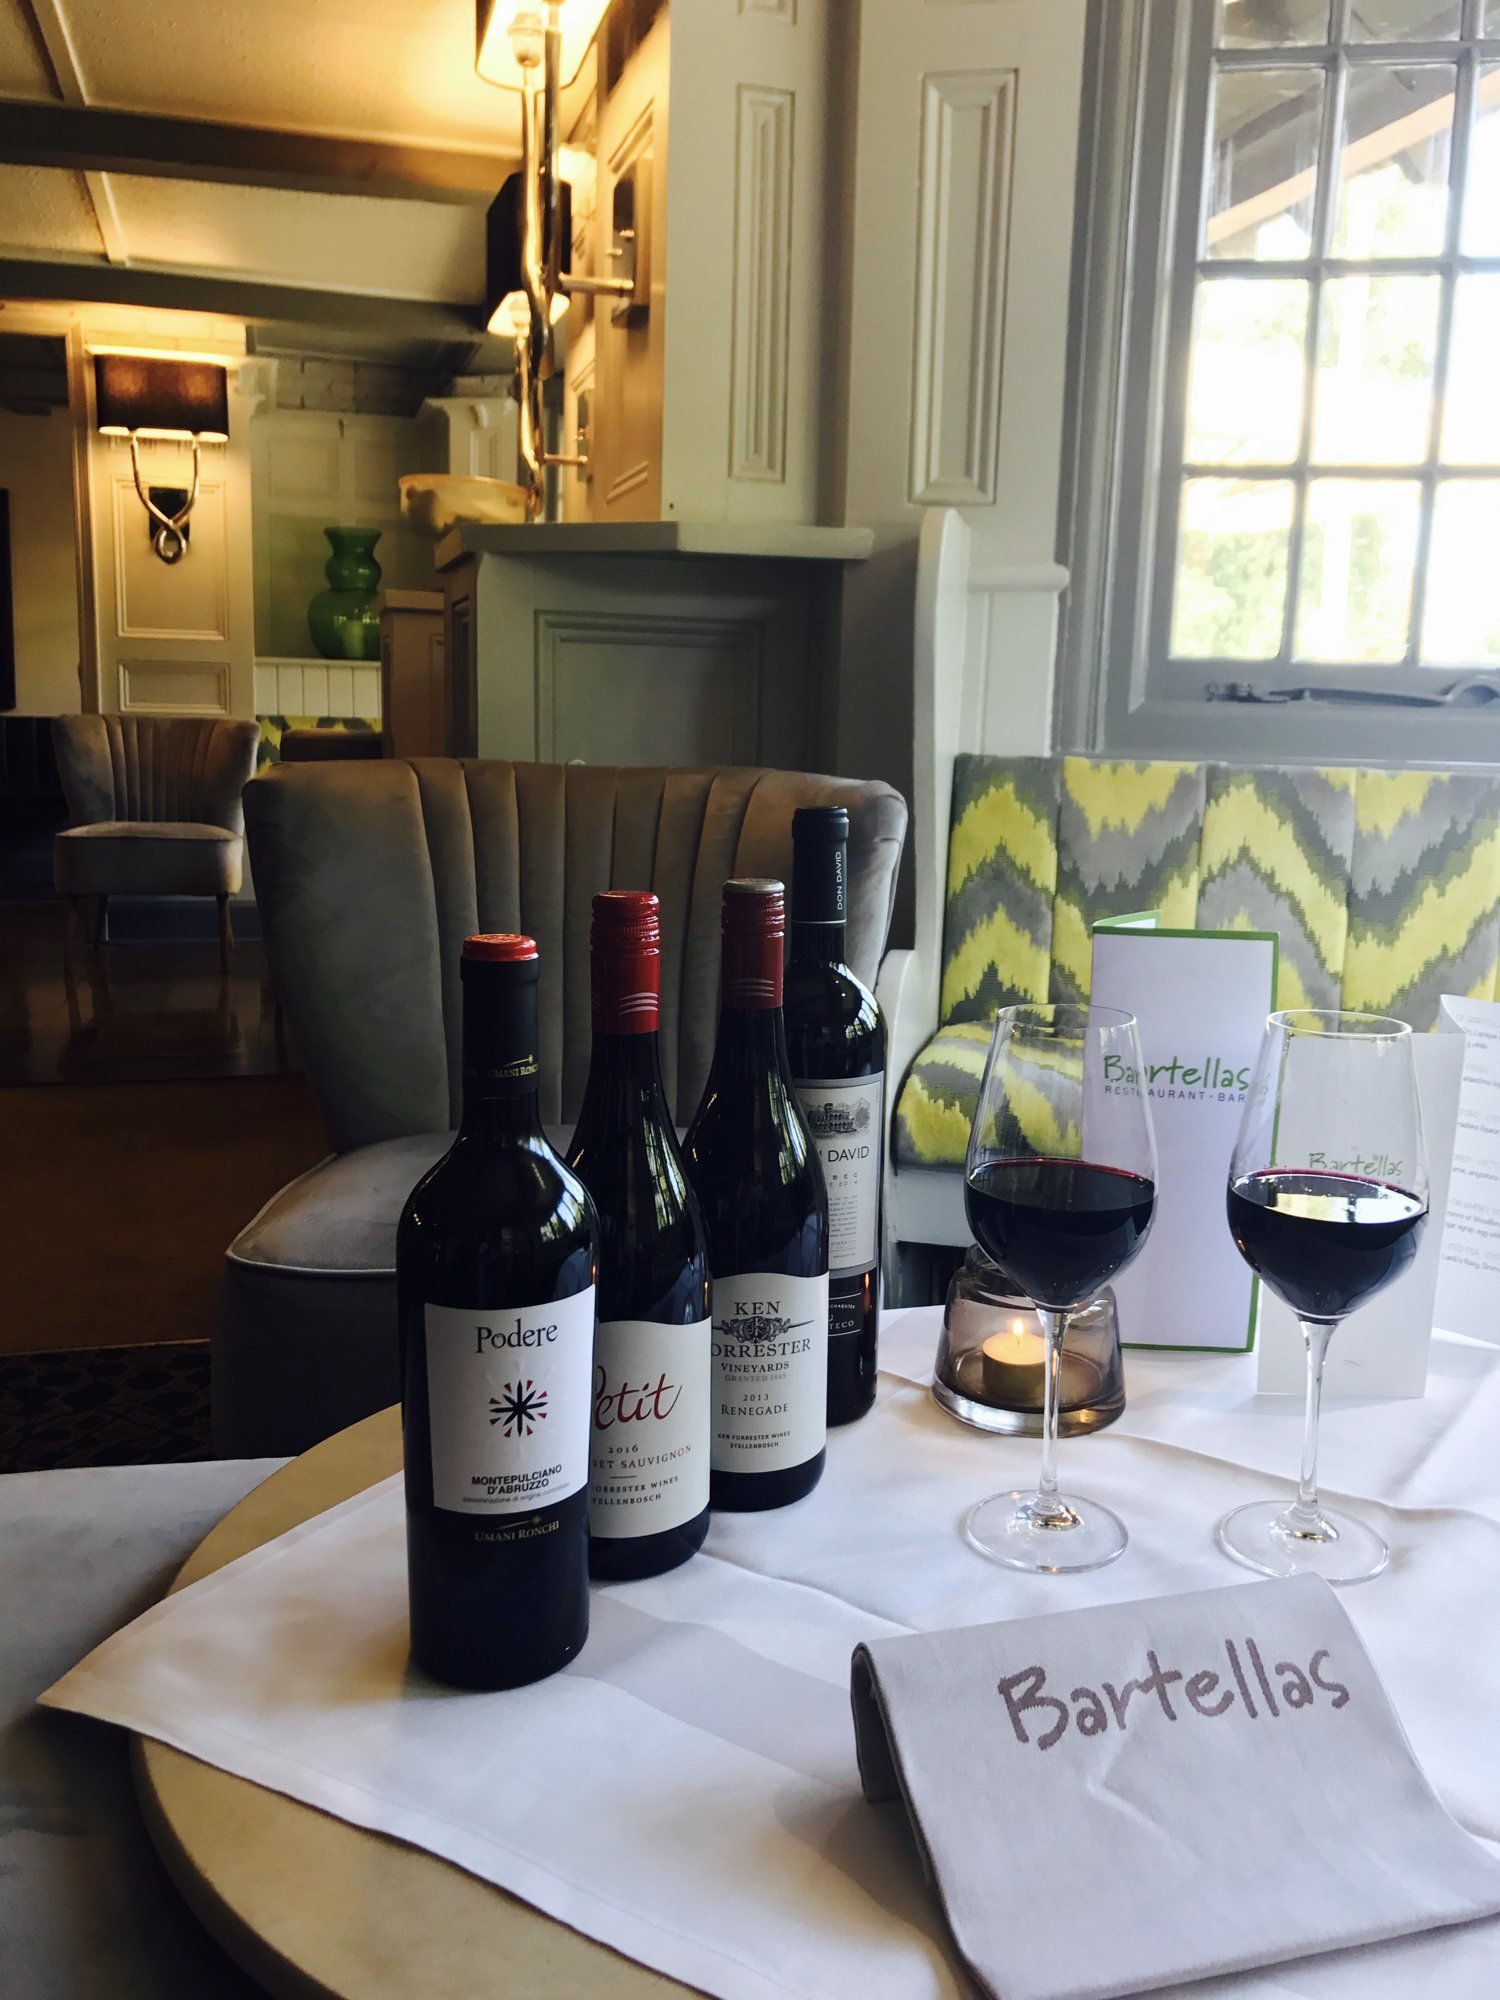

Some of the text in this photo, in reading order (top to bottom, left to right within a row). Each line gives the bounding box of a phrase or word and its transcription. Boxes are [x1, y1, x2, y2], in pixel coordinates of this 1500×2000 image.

[835, 851, 843, 882] DAVID
[1103, 1054, 1250, 1091] Bartellas
[828, 1145, 870, 1163] DAVID
[1308, 1152, 1403, 1176] Bartellas
[734, 1300, 781, 1316] KEN
[828, 1319, 855, 1330] TECO
[475, 1318, 558, 1354] Podere
[711, 1338, 811, 1358] ORRESTER
[721, 1361, 790, 1374] VINEYARDS
[742, 1393, 769, 1402] 2013
[721, 1403, 789, 1416] RENEGADE
[717, 1430, 791, 1441] KEN FORRESTER WINES
[608, 1443, 640, 1454] 2016
[729, 1441, 779, 1449] STELLENBOSCH
[620, 1444, 693, 1469] SAUVIGNON
[471, 1463, 563, 1486] MONTEPULCIANO
[487, 1478, 550, 1495] D'ABRUZZO
[594, 1475, 679, 1493] ORRESTER WINES
[591, 1492, 662, 1506] TELLENBOSCH
[474, 1520, 560, 1543] UMANI RONCHI
[996, 1637, 1350, 1751] Bartellas
